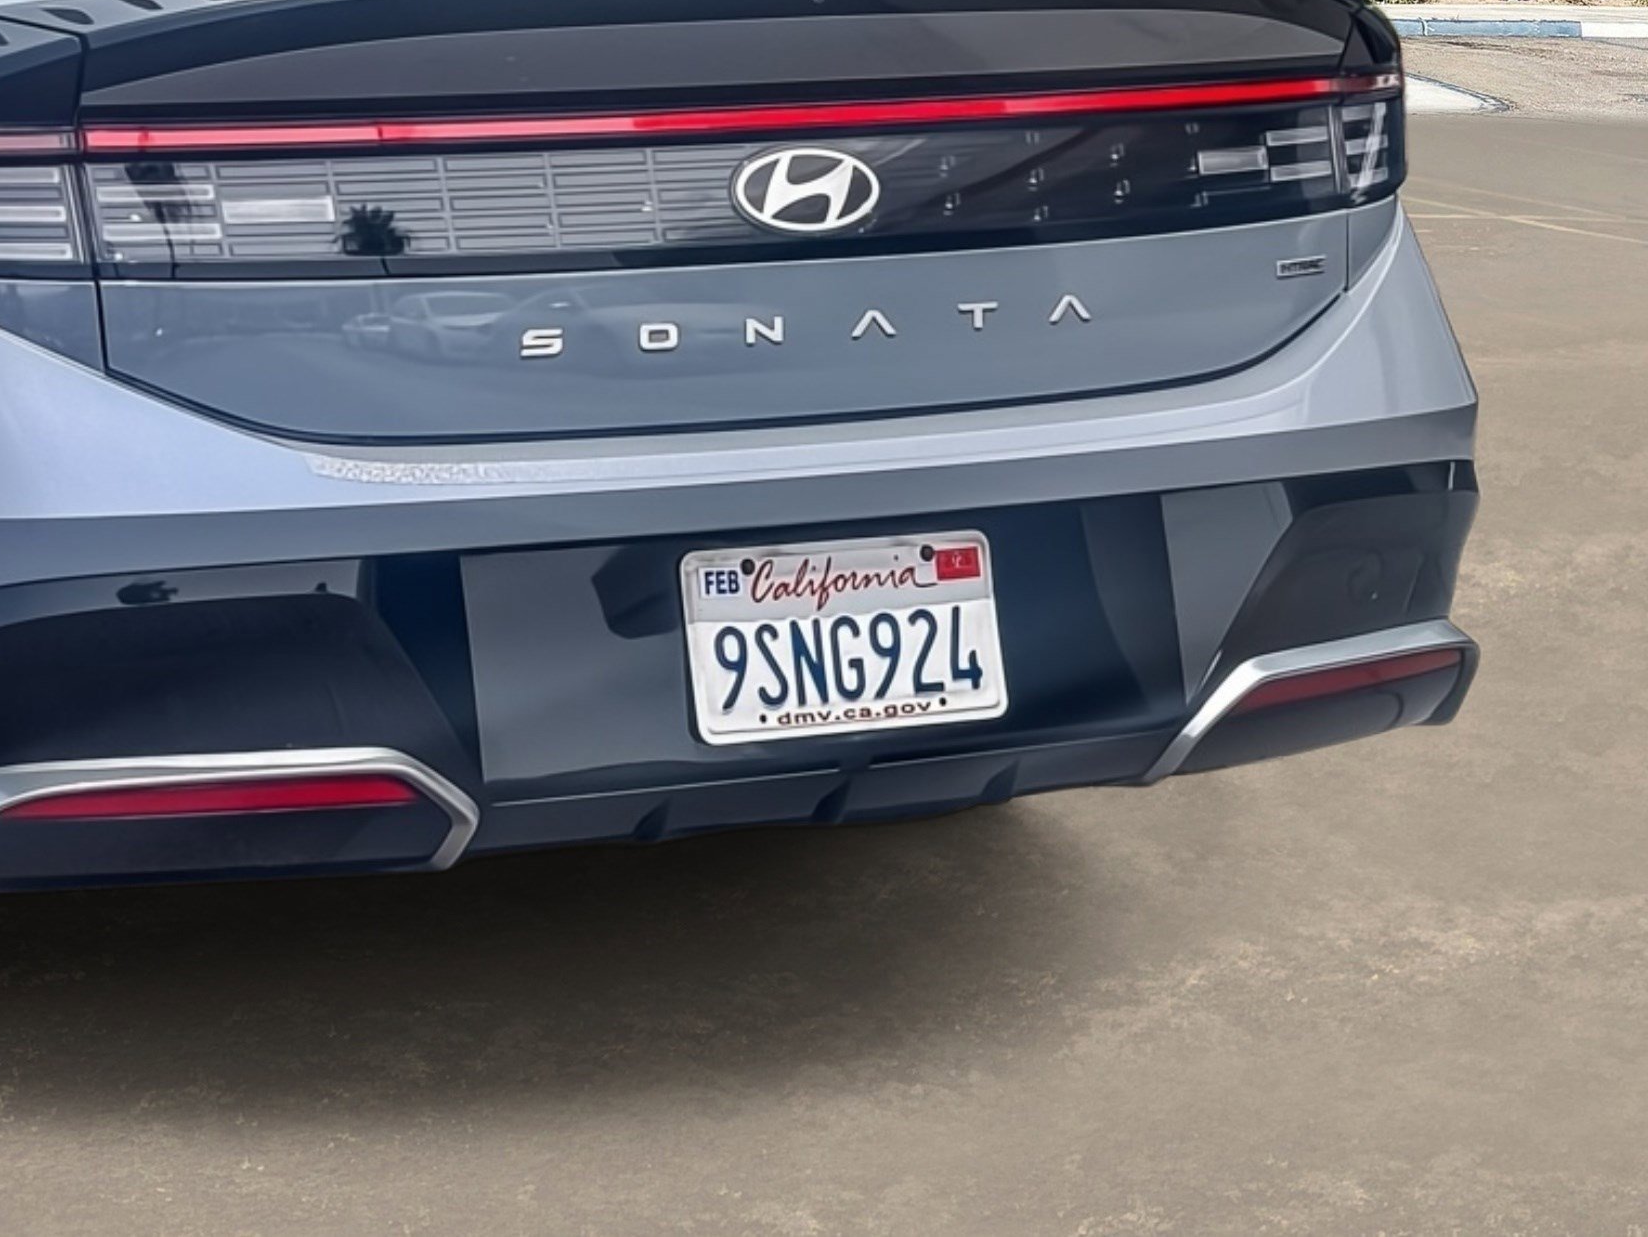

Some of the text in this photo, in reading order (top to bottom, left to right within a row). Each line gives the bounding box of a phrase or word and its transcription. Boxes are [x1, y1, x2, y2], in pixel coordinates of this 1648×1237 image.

[520, 294, 1092, 357] SONATA
[704, 557, 937, 610] FEB California
[713, 605, 984, 712] 9SNG924
[776, 699, 932, 726] dmv.ca.gov
